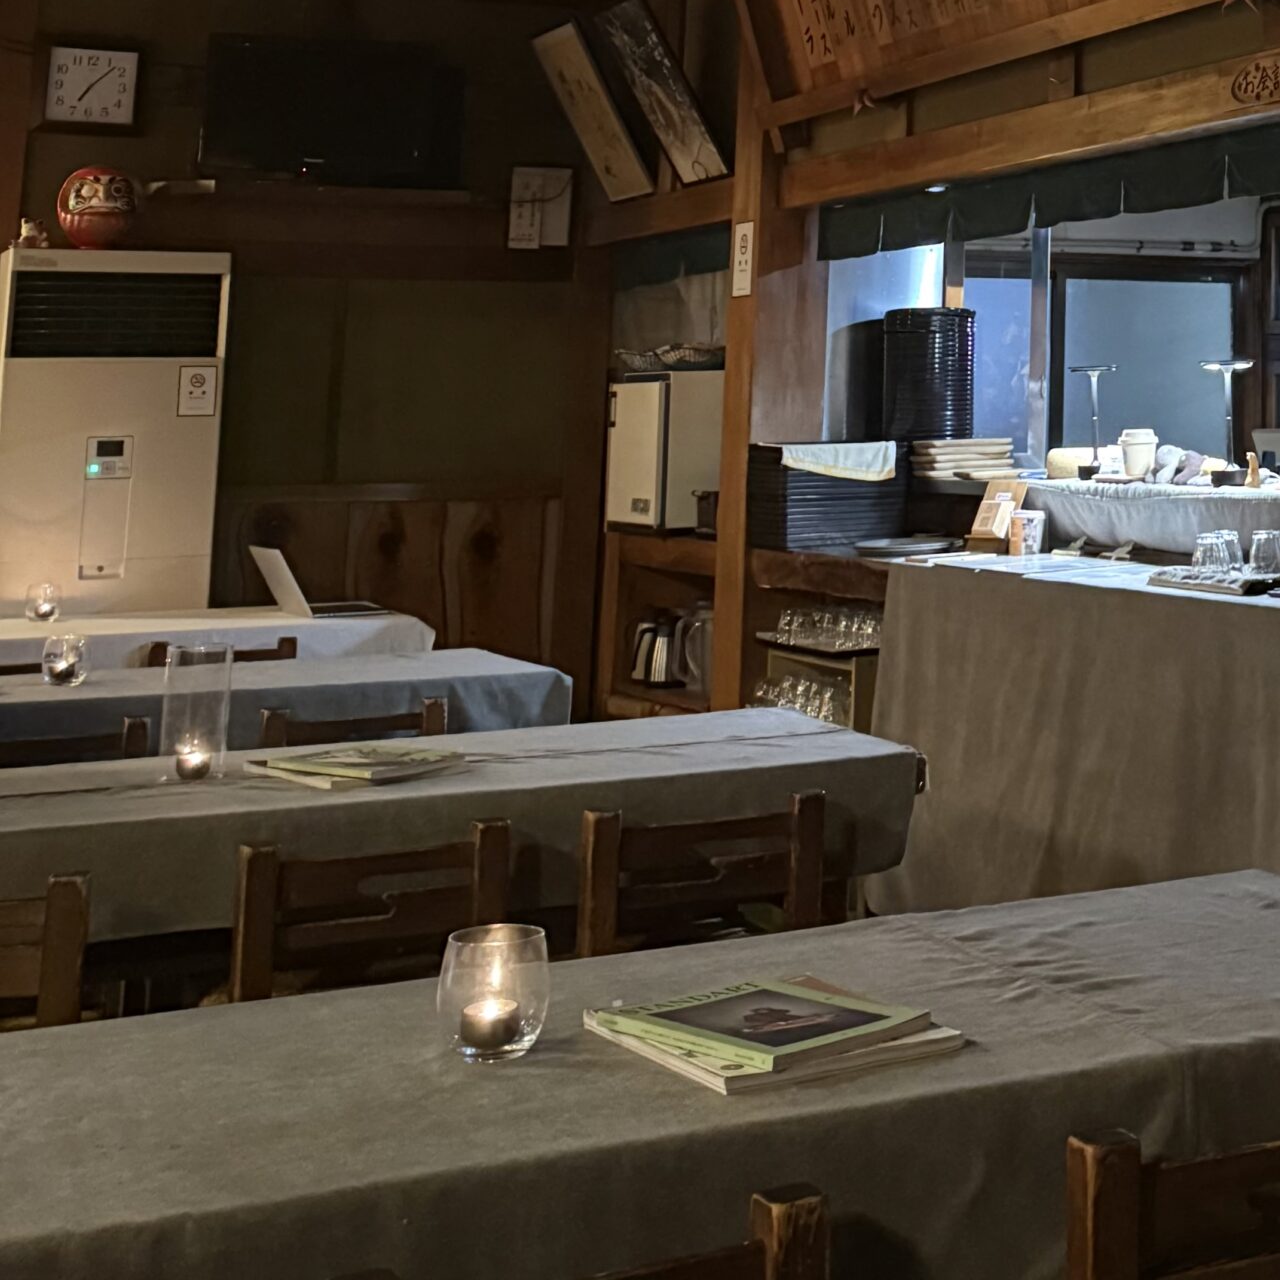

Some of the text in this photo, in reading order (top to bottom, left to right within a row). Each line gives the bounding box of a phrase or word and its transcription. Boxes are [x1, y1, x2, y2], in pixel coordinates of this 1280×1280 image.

[73, 55, 83, 66] 11
[87, 55, 99, 67] 12
[56, 63, 69, 74] 10
[117, 66, 127, 78] 2
[55, 79, 64, 89] 9
[118, 82, 127, 94] 3
[55, 95, 64, 106] 8
[113, 99, 121, 109] 4
[69, 105, 77, 116] 7
[83, 107, 93, 118] 6
[100, 107, 109, 117] 5
[618, 982, 760, 1016] STANDART
